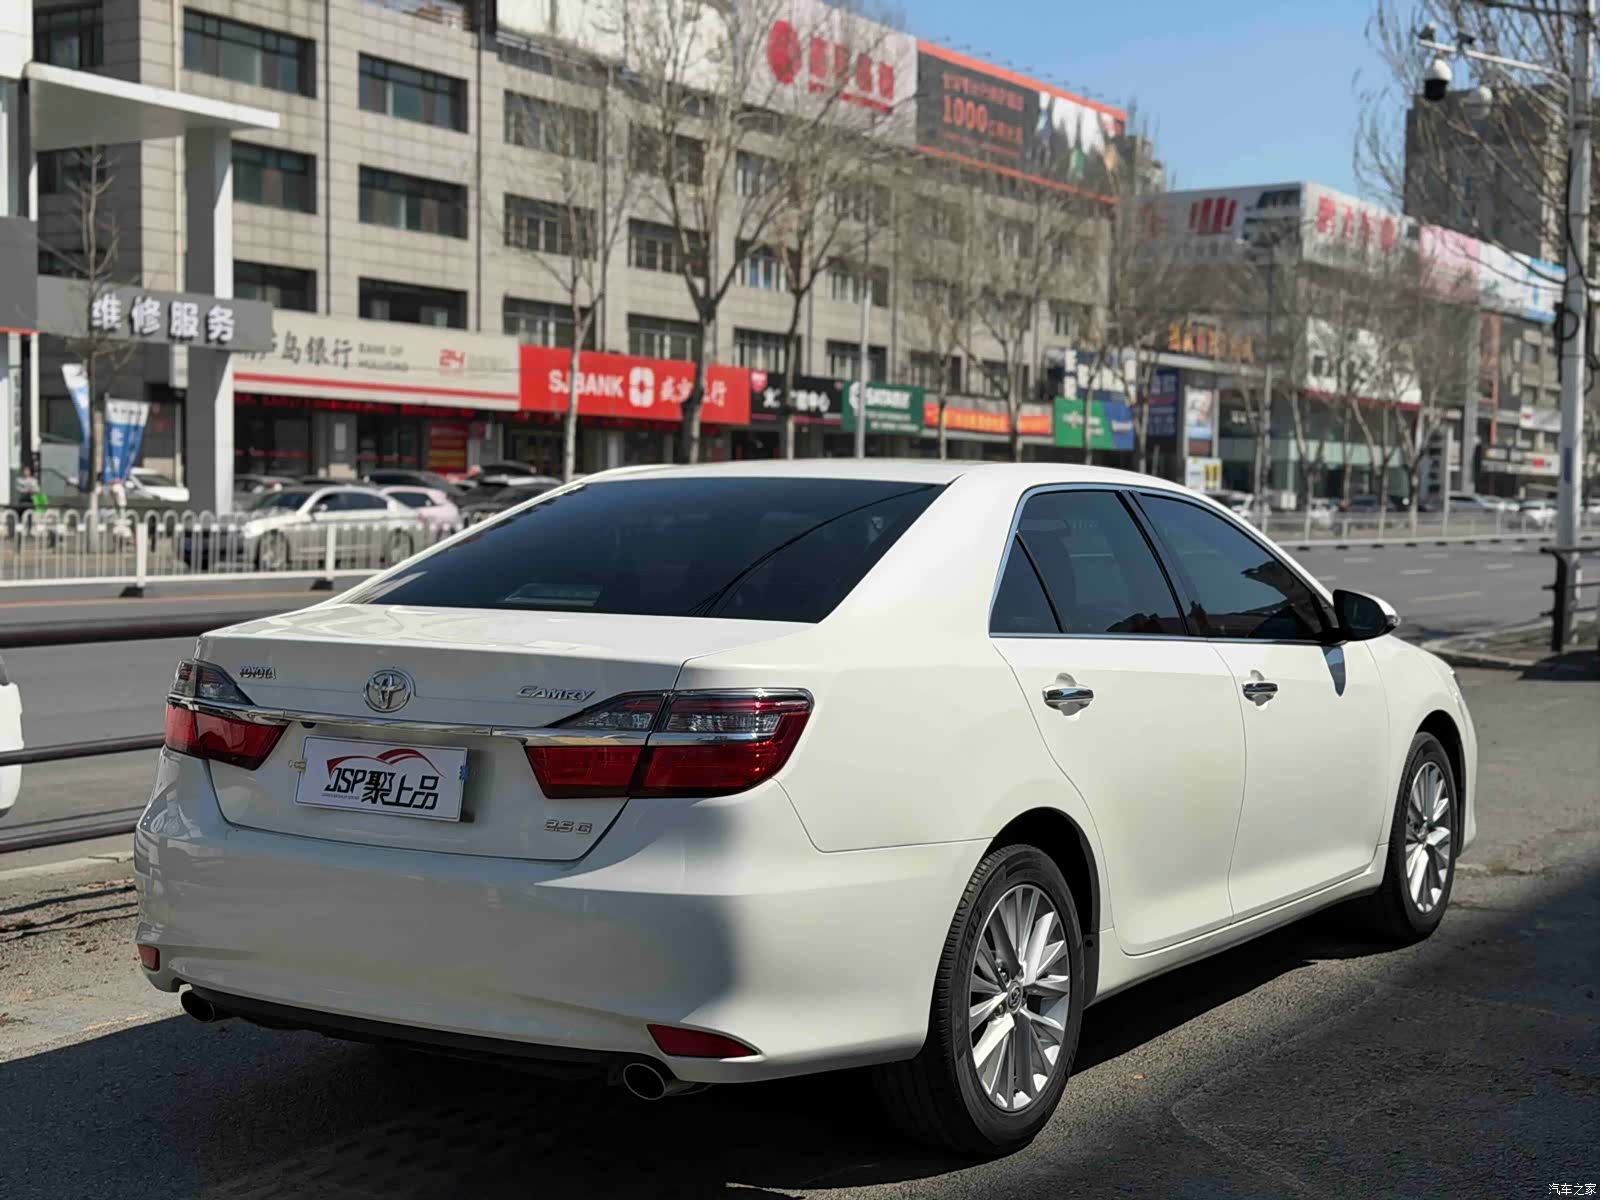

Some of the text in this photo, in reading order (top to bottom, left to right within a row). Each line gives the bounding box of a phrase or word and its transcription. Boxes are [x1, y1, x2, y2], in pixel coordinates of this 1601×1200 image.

[943, 95, 988, 133] 1000
[91, 293, 235, 343] 维修服务
[439, 348, 465, 368] 24
[240, 665, 277, 680] TOYOTA
[516, 685, 596, 702] CAMRY
